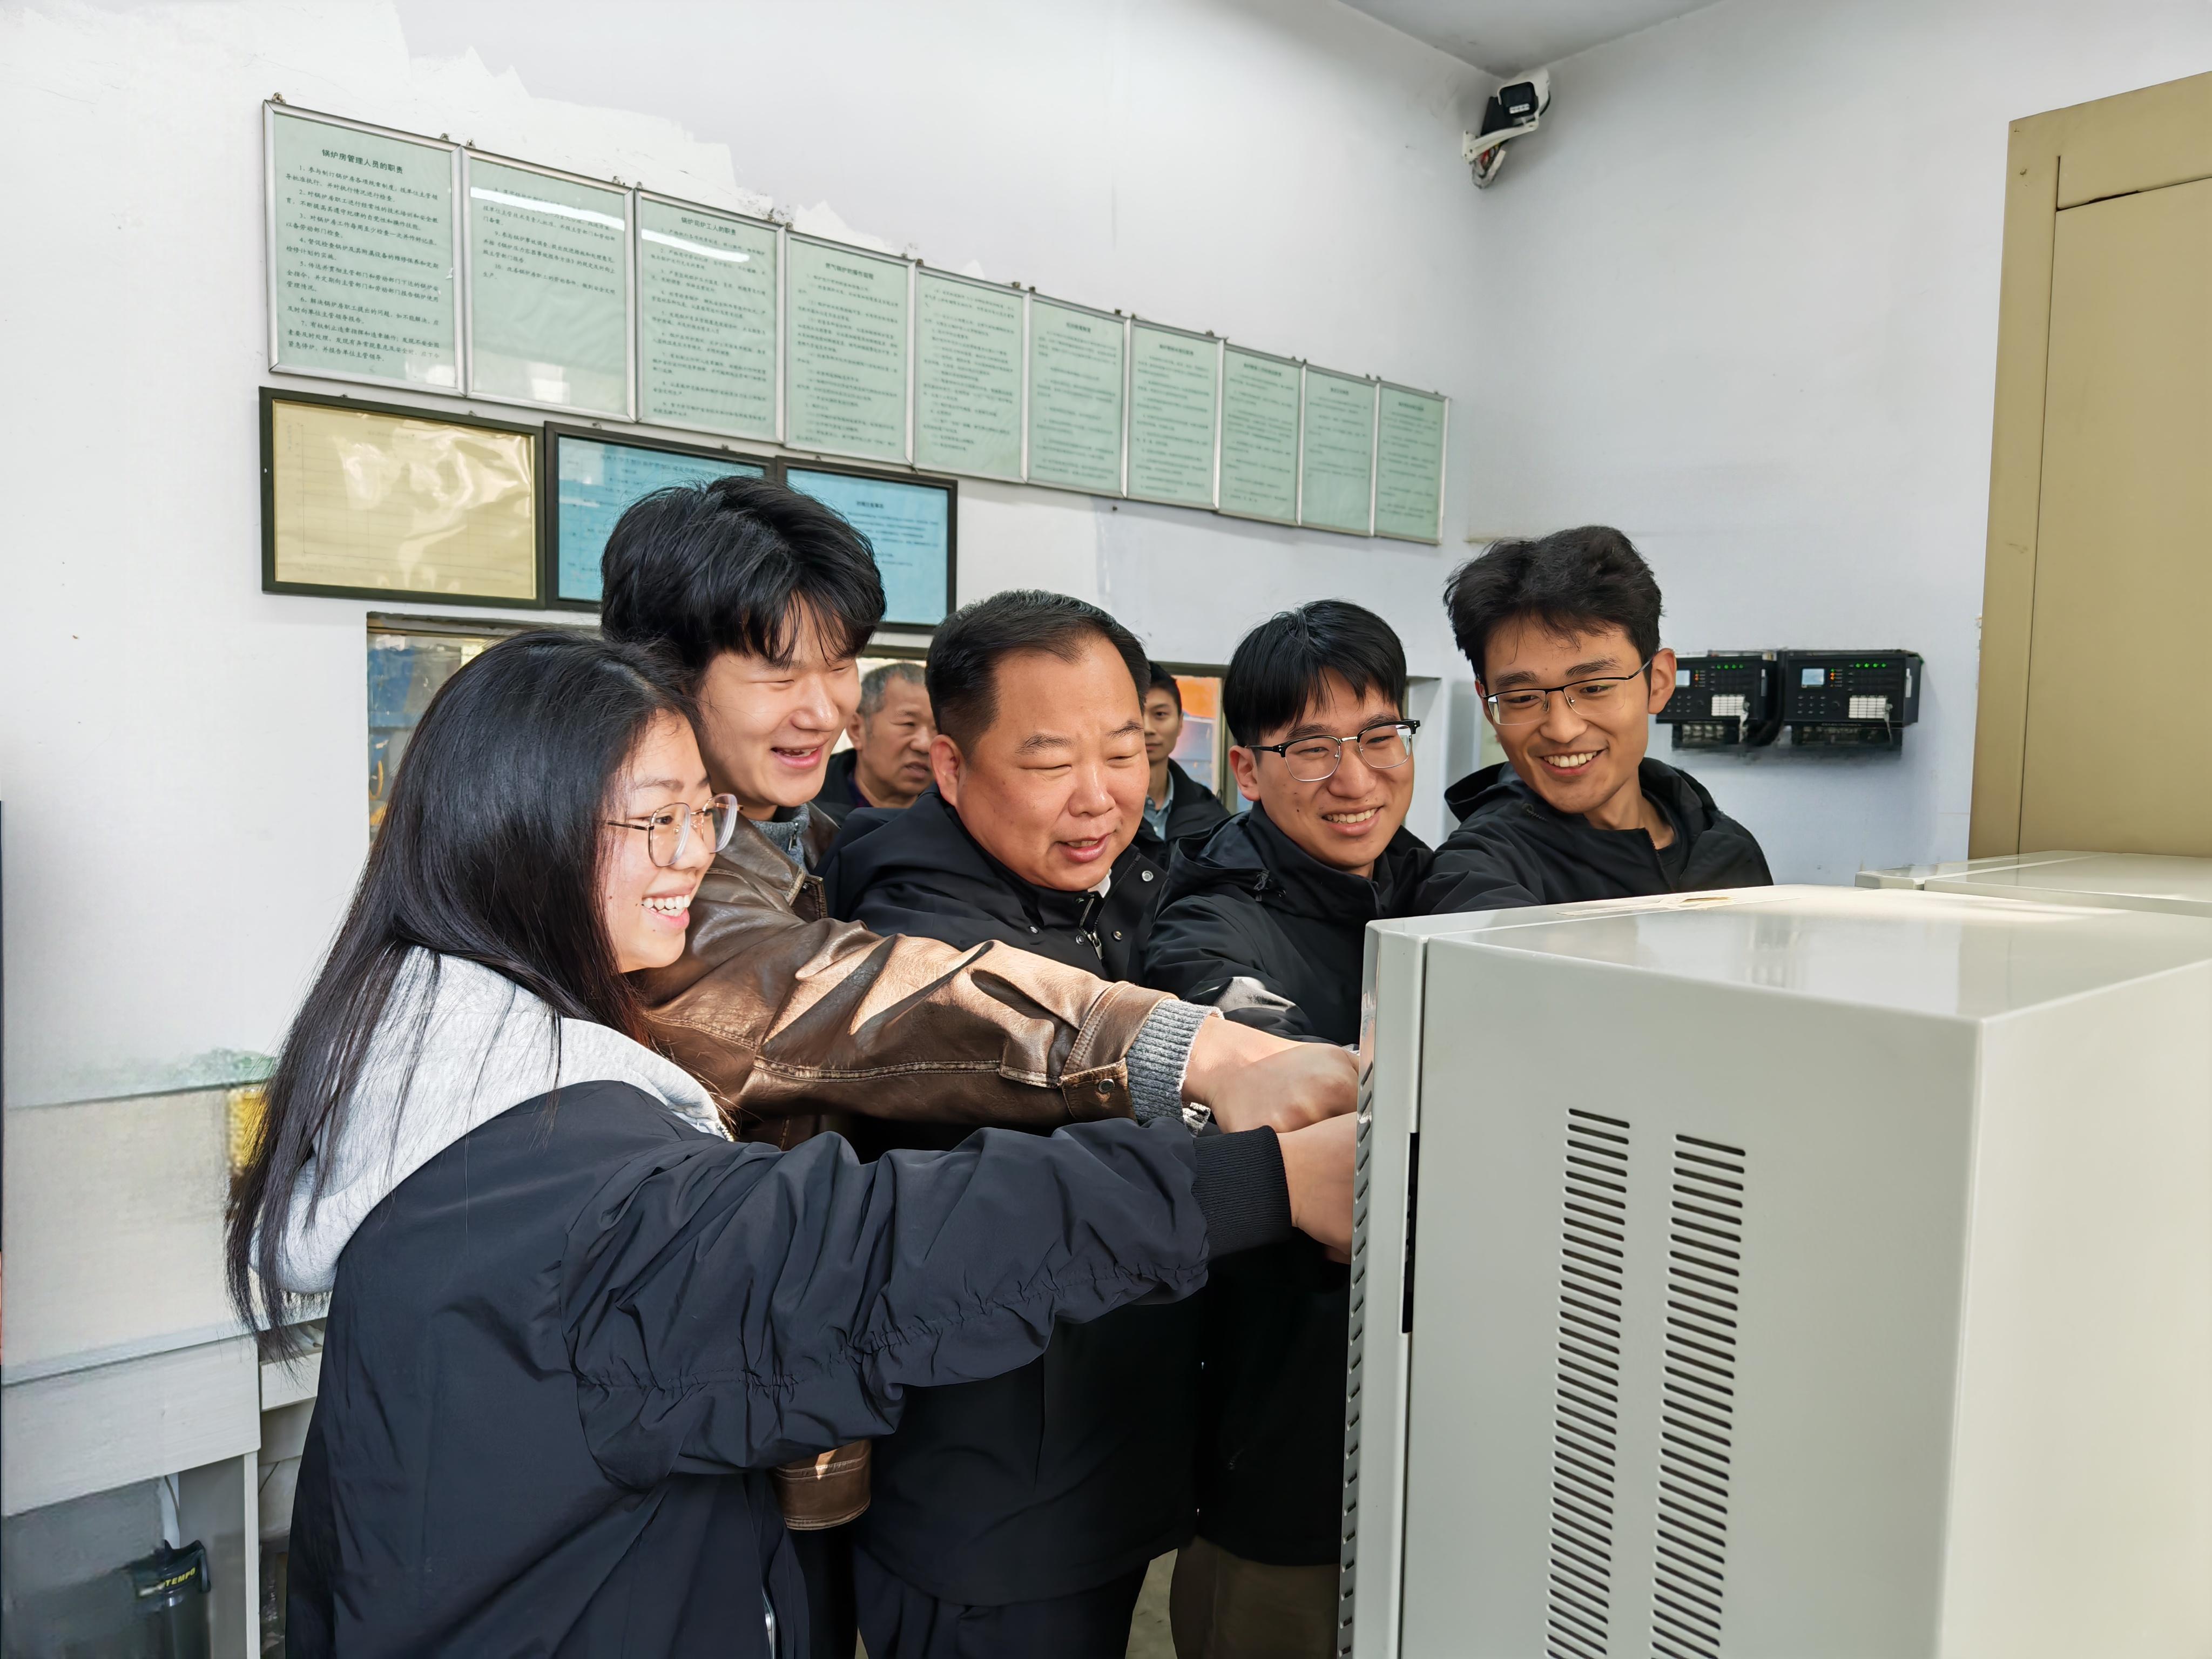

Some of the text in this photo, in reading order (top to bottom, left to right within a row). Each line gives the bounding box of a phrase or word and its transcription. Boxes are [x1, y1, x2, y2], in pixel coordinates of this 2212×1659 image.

[321, 149, 403, 174] 锅炉房管理人员的职责
[681, 216, 736, 236] 锅炉司炉工人的职责
[163, 1566, 196, 1588] TEMPO
